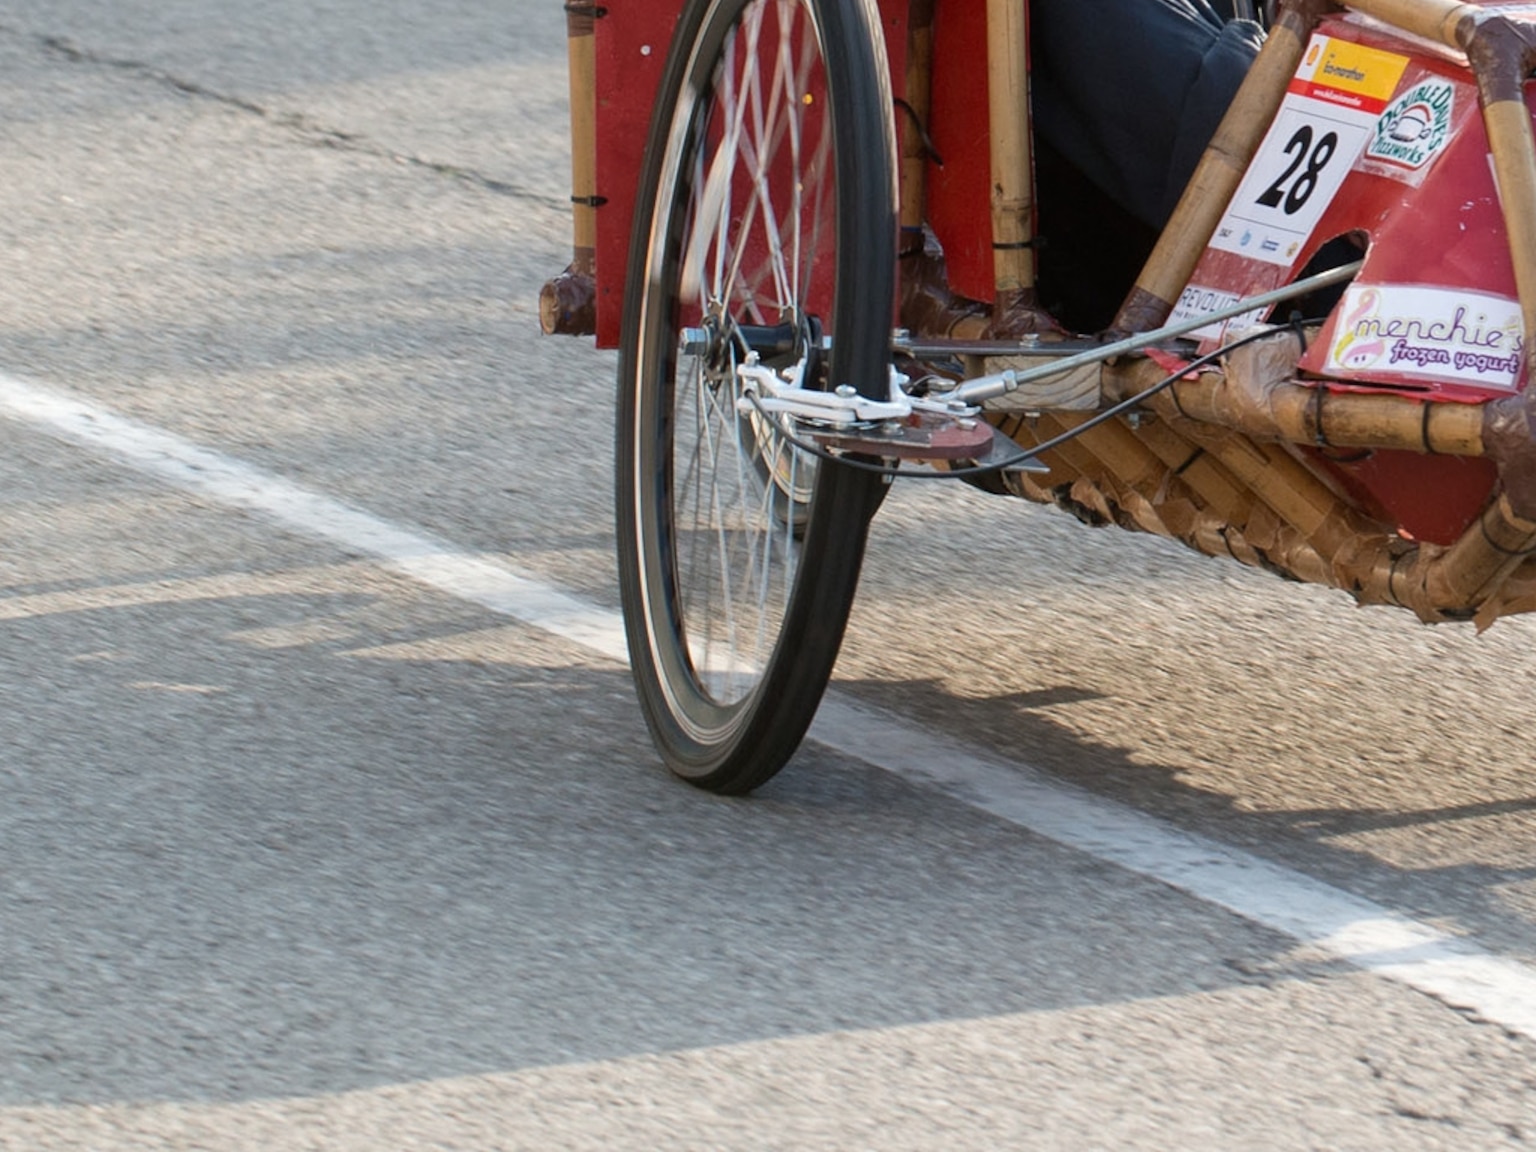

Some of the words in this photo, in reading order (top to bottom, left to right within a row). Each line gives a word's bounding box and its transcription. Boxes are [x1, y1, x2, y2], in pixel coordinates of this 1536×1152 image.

[1254, 124, 1339, 217] 28
[1389, 338, 1449, 367] frozen
[1454, 351, 1519, 374] yogurt
